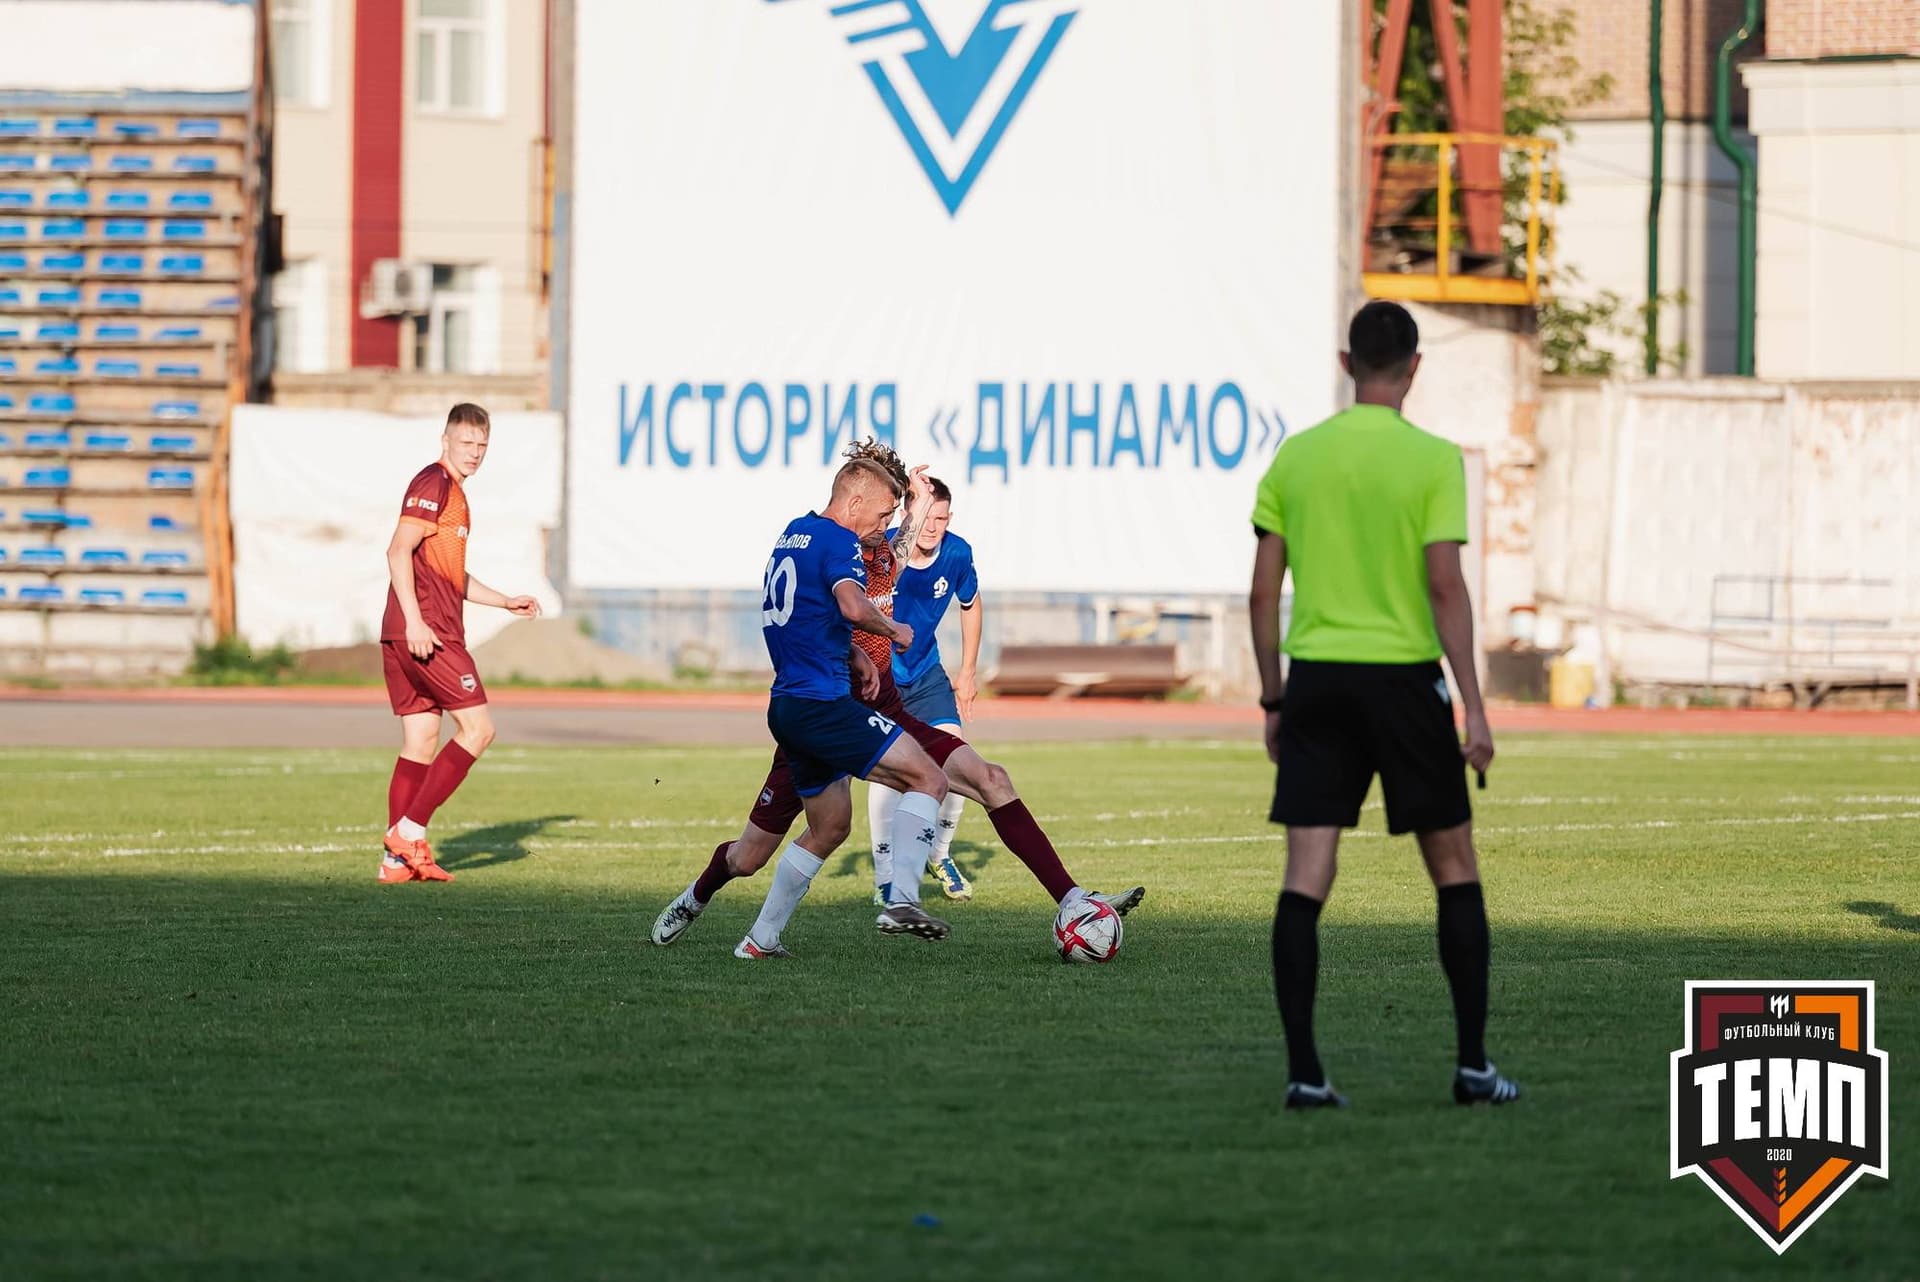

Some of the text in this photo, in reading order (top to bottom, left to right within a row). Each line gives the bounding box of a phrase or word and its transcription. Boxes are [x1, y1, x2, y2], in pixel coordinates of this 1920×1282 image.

[618, 381, 1286, 483] ИСТОРИЯ «ДИНАМО»
[868, 710, 896, 735] 2
